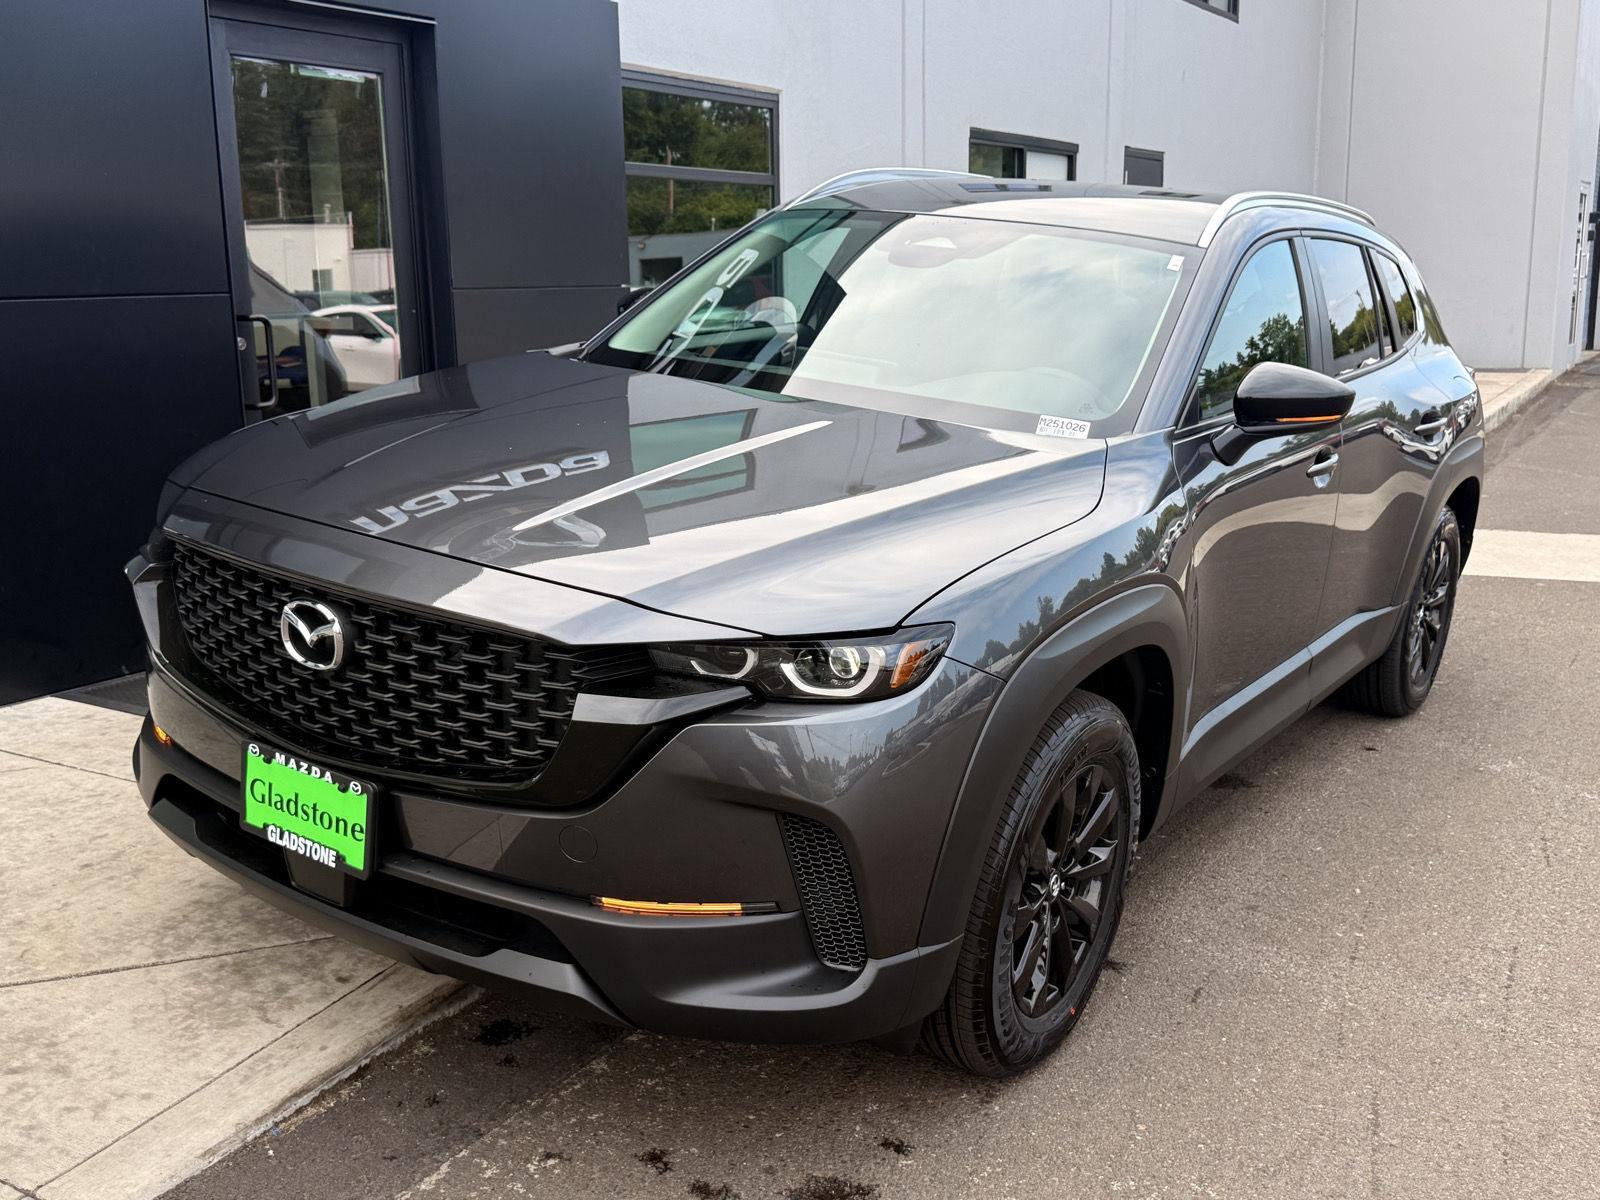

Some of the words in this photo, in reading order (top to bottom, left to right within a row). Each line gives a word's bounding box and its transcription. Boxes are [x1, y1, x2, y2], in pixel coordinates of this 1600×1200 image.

[1039, 417, 1086, 432] M251026
[275, 752, 333, 783] MAZDA
[250, 778, 365, 842] Gladstone
[267, 824, 337, 868] GLADSTONE
